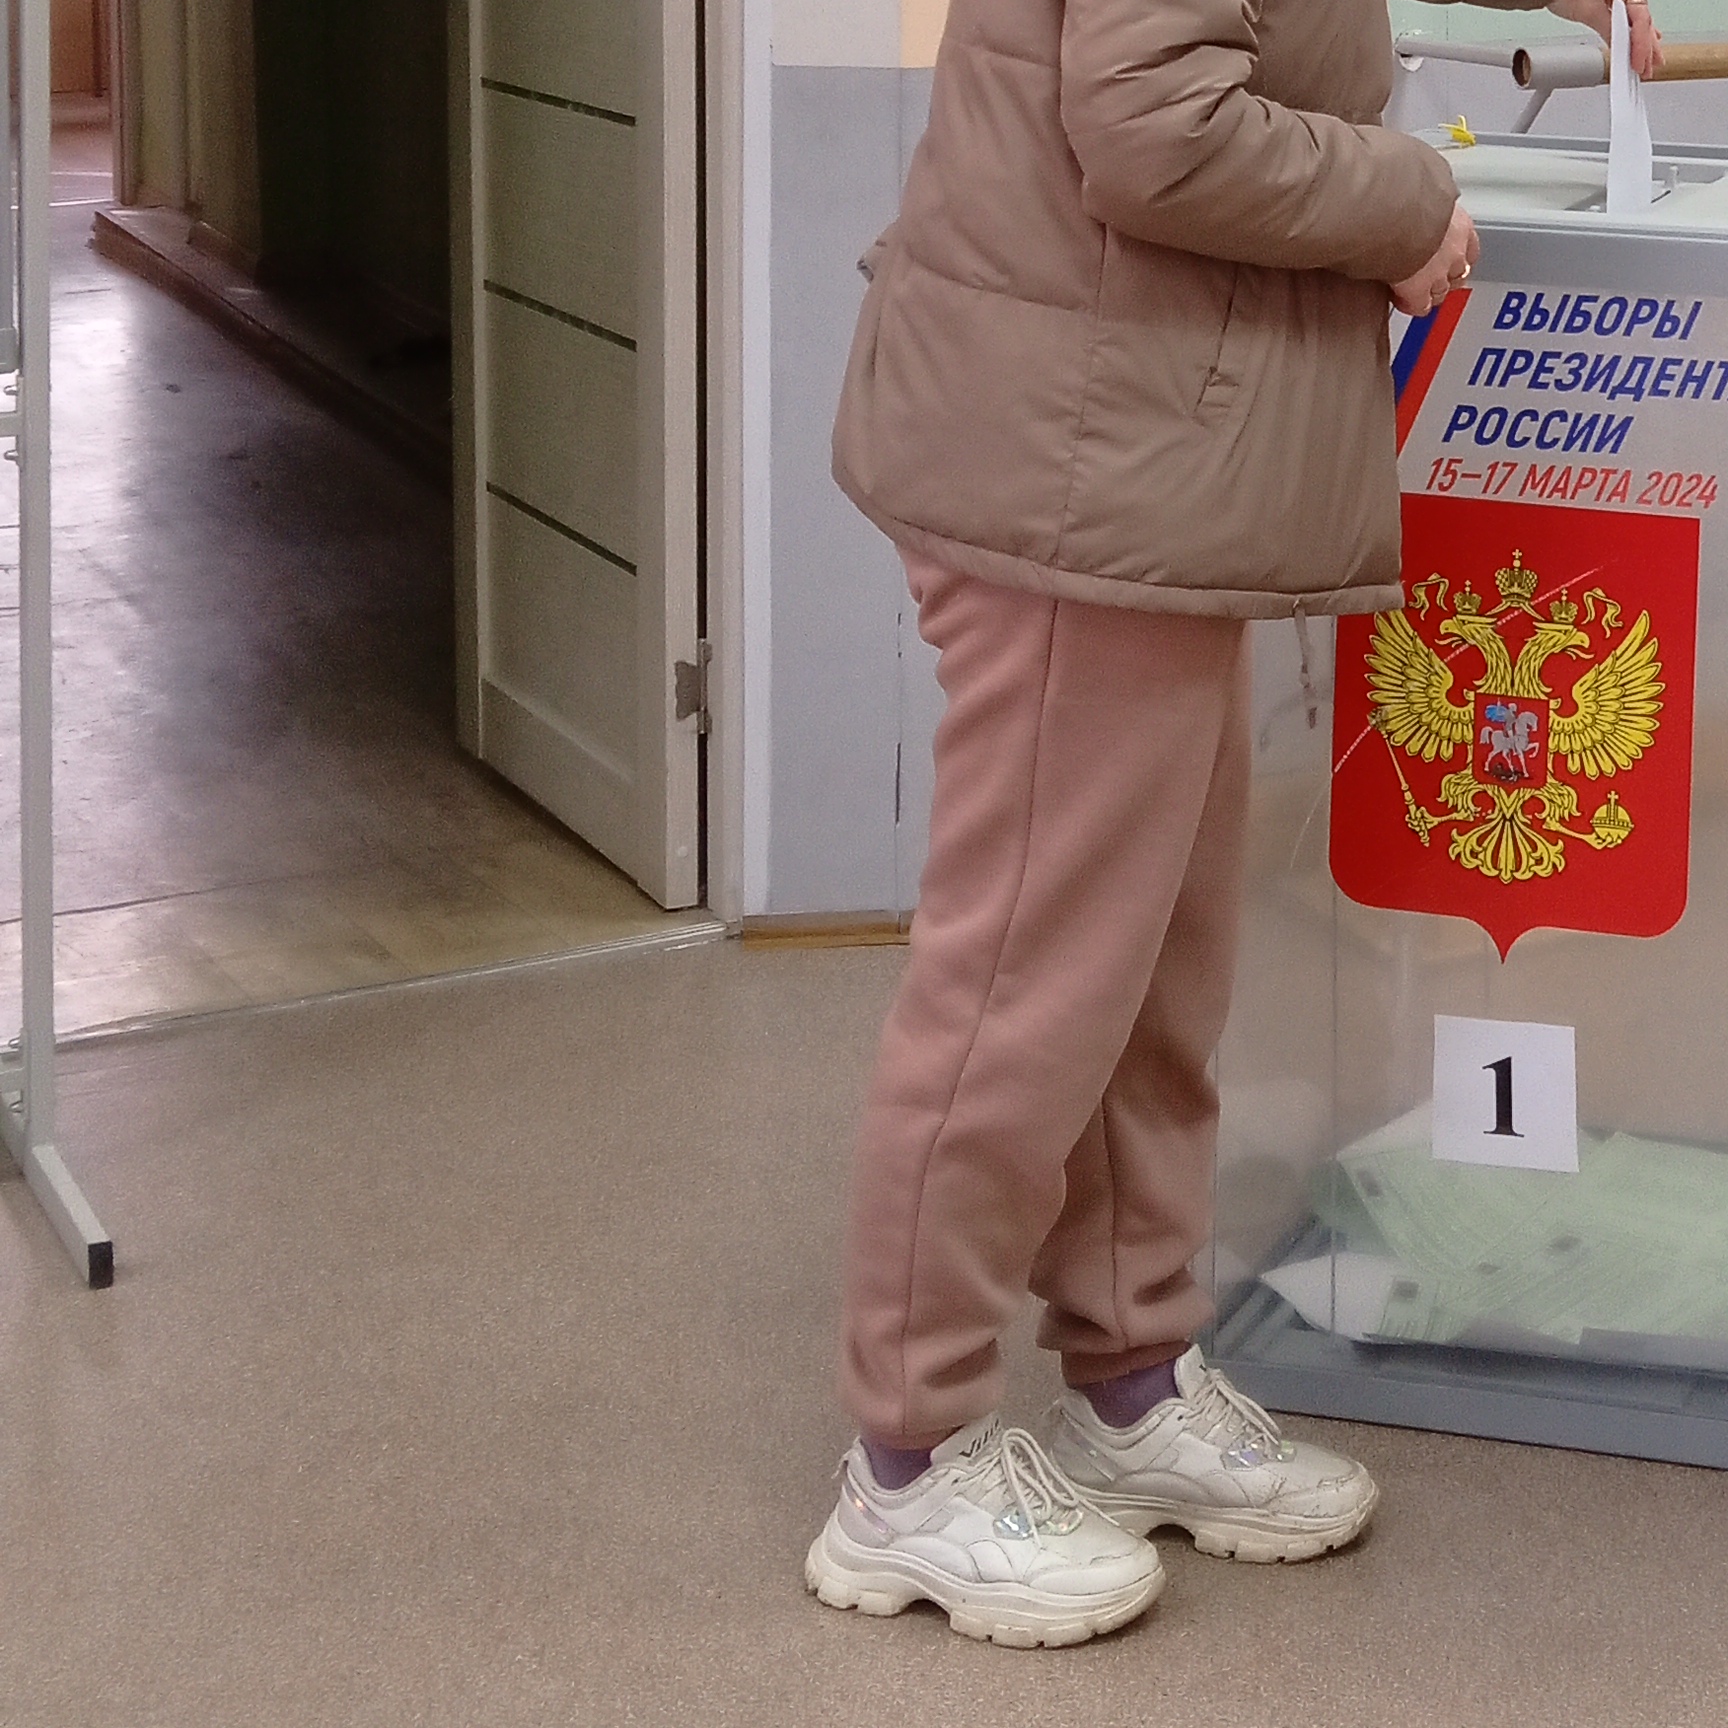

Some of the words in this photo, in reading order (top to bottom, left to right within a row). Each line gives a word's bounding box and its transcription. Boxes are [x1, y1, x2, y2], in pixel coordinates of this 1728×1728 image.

[1493, 291, 1703, 340] ВЫБОРЫ
[1442, 404, 1635, 454] РОССИИ
[1518, 463, 1632, 503] МАРТА
[1636, 472, 1719, 509] 2024
[1482, 1056, 1525, 1138] 1
